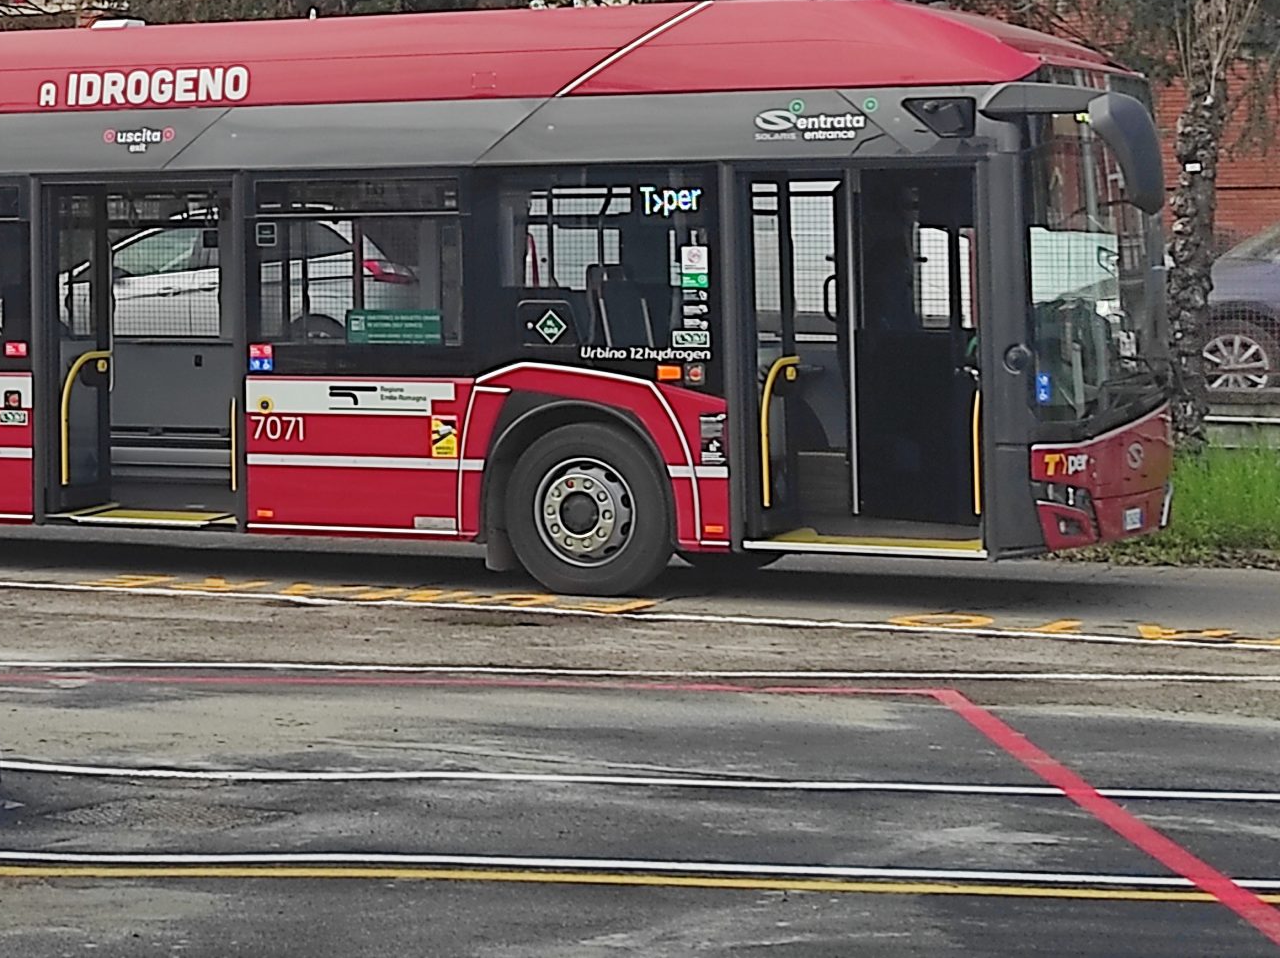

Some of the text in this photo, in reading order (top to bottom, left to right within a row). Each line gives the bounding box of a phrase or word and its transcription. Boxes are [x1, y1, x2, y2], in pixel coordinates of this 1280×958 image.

[39, 66, 249, 107] A IDROGENO
[796, 114, 866, 129] entrata
[117, 128, 162, 143] uscita
[754, 132, 796, 141] SOLARIS
[803, 129, 856, 140] entrance
[580, 346, 711, 362] Urbino 12 hydrogen
[250, 415, 305, 441] 7071
